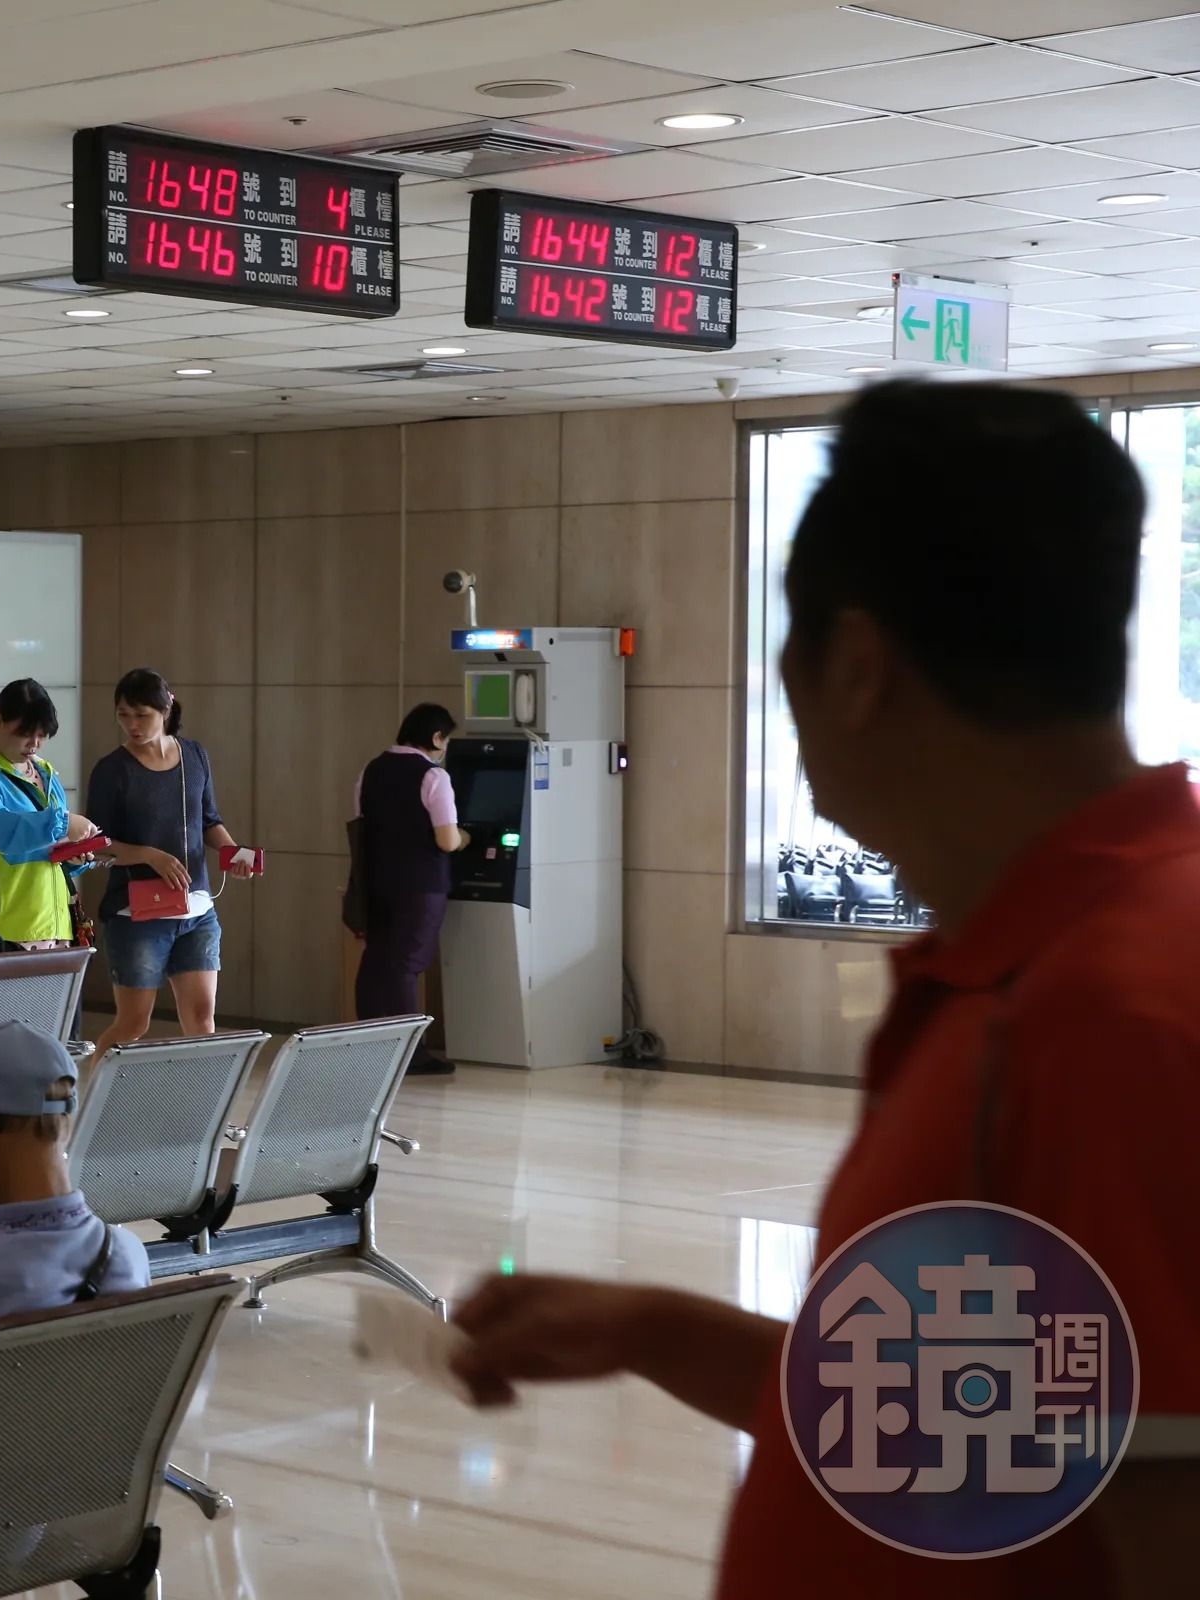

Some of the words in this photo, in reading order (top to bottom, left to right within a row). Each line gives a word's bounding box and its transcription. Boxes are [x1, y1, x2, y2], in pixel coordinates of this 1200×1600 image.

[108, 150, 127, 184] 請
[145, 159, 238, 217] 1648
[327, 186, 348, 231] 4
[109, 190, 128, 203] NO.
[243, 208, 255, 221] TO
[256, 210, 297, 227] COUNTER
[354, 224, 391, 240] PLEASE
[108, 211, 127, 246] 請
[145, 221, 236, 277] 1646
[311, 244, 348, 292] 10
[503, 212, 521, 244] 請
[530, 217, 611, 266] 1644
[664, 234, 697, 278] 12
[504, 244, 519, 255] NO.
[614, 256, 625, 267] TO
[625, 257, 658, 271] COUNTER
[701, 267, 730, 281] PLEASE
[108, 251, 128, 265] NO.
[245, 269, 257, 282] TO
[258, 272, 298, 287] COUNTER
[356, 282, 392, 298] PLEASE
[500, 266, 518, 295] 請
[529, 275, 608, 322] 1642
[662, 289, 693, 333] 12
[501, 295, 515, 306] NO.
[613, 311, 624, 321] TO
[624, 312, 656, 324] COUNTER
[700, 322, 728, 333] PLEASE
